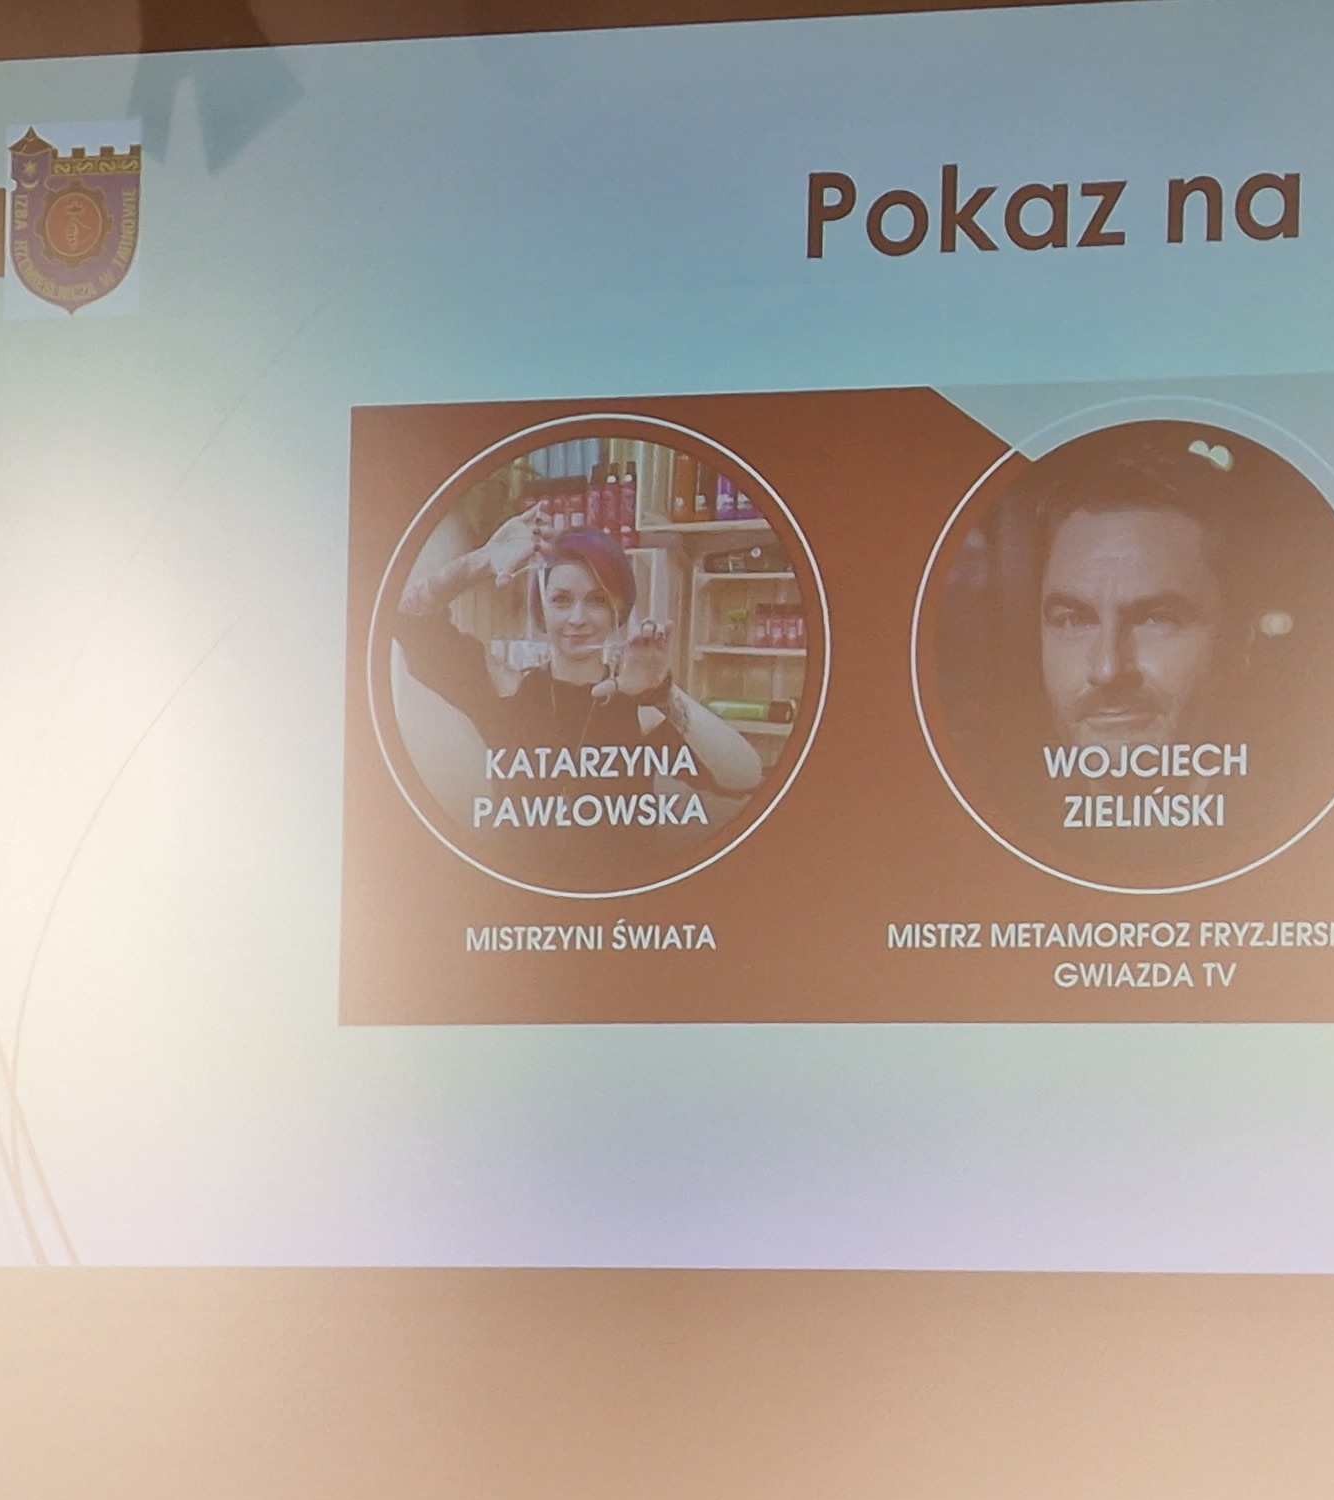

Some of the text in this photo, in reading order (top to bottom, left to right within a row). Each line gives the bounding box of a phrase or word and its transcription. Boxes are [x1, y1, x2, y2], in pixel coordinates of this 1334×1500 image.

[806, 163, 1128, 259] Pokaz
[1166, 172, 1301, 244] na
[484, 744, 698, 780] KATARZYNA
[1043, 743, 1247, 779] WOJCIECH
[472, 793, 709, 828] PAWŁOWSKA
[1063, 786, 1224, 828] ZIELIŃSKI
[465, 918, 717, 952] MISTRZYNI ŚWIATA
[887, 923, 982, 949] MISTRZ
[990, 922, 1191, 948] METAMORFOZ
[1054, 962, 1237, 988] GWIAZDA TV
